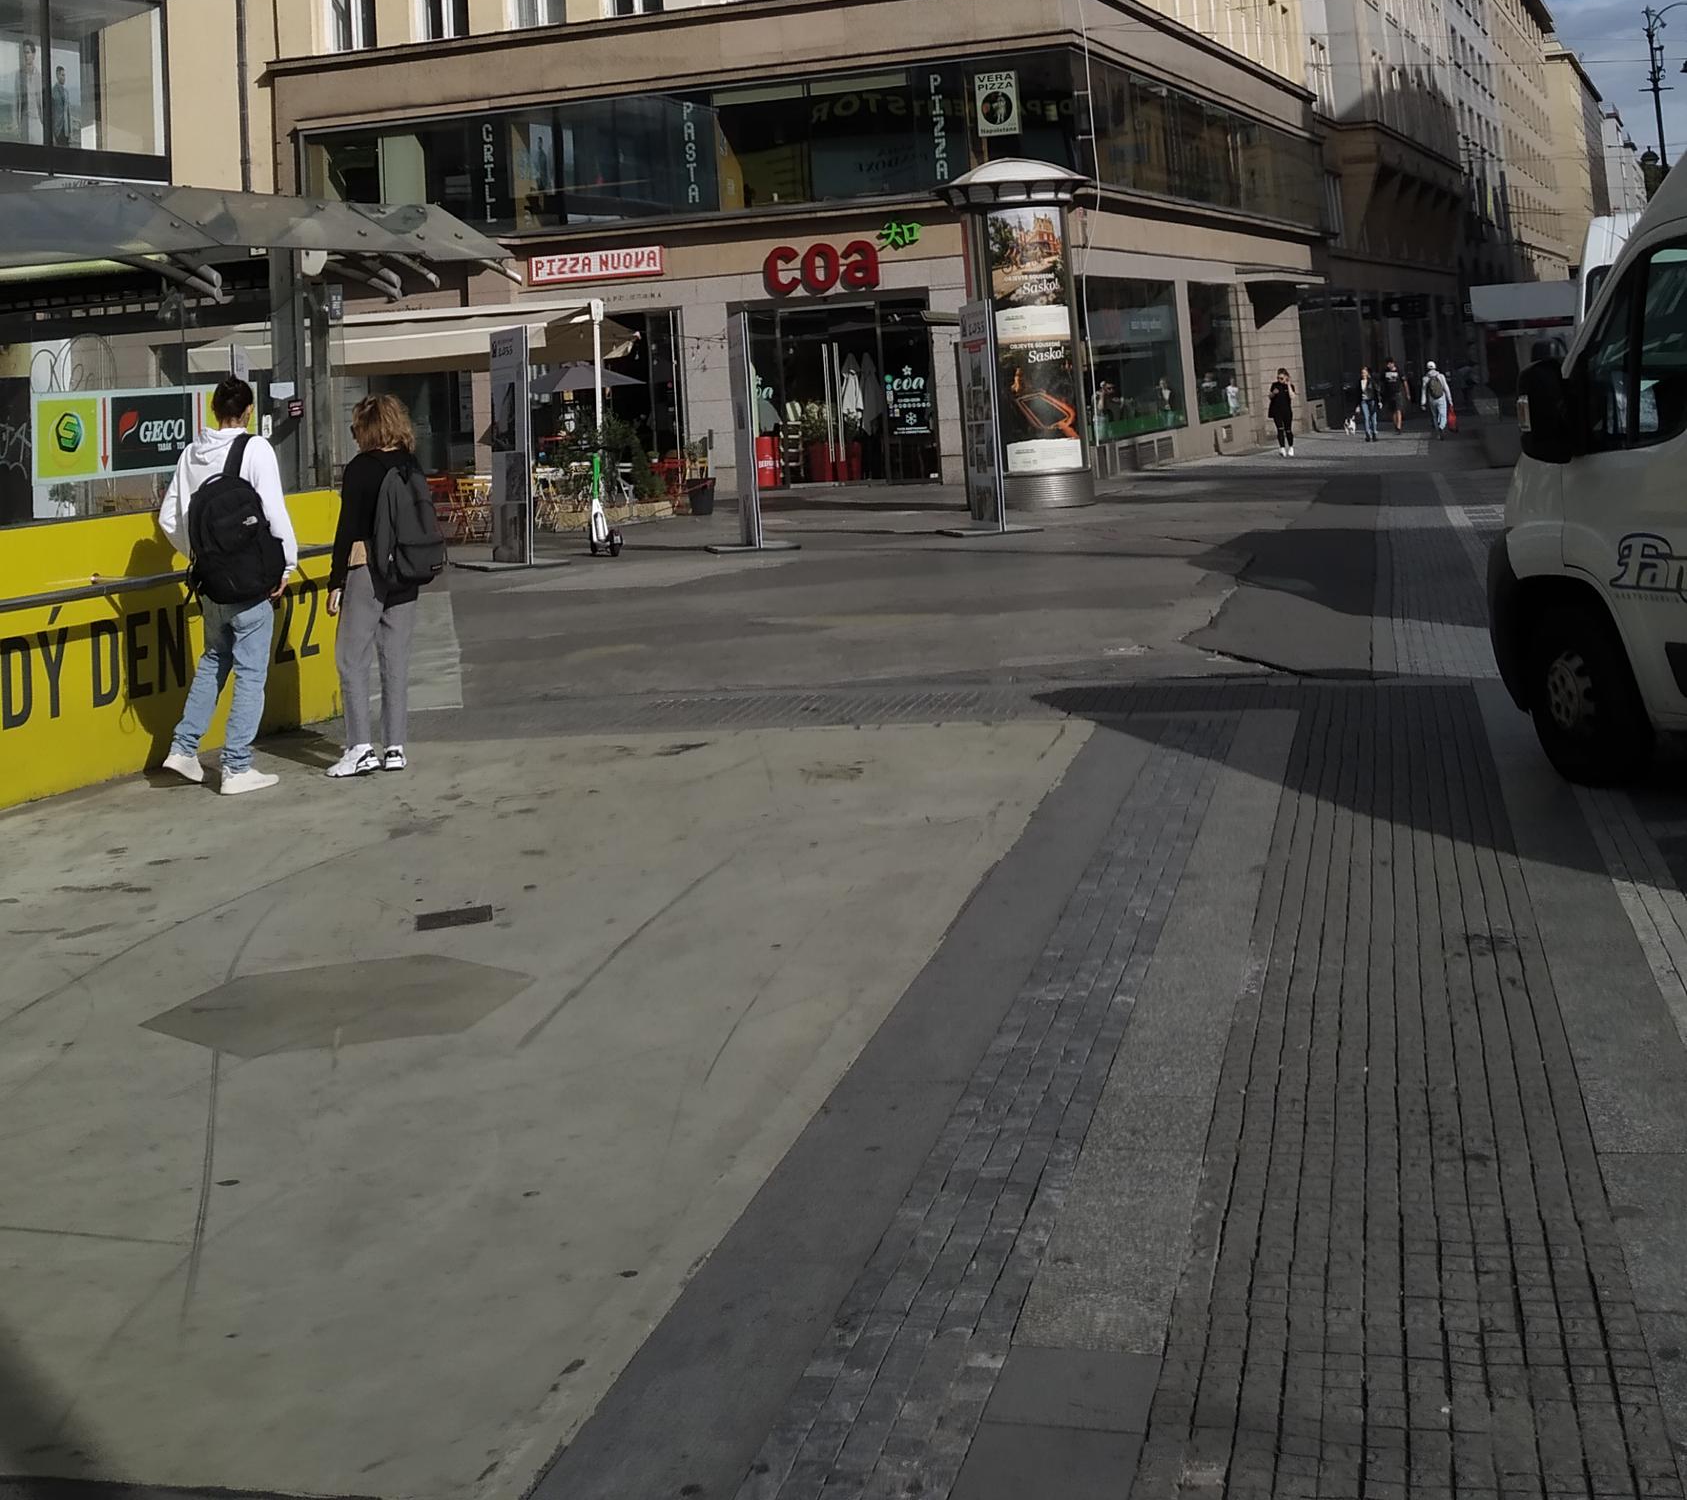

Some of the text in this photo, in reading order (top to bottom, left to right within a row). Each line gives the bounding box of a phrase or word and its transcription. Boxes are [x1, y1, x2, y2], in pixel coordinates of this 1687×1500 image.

[977, 73, 1013, 83] VERA
[977, 81, 1014, 91] PIZZA
[929, 73, 949, 180] PIZZA
[682, 101, 700, 204] PASTA
[482, 123, 498, 223] GRILL
[535, 250, 657, 278] PIZZA NUOVA
[763, 239, 880, 298] coa
[1022, 278, 1060, 295] Sasko!
[1028, 346, 1065, 363] Sasko!
[892, 376, 925, 391] coa
[139, 418, 186, 443] GECO
[90, 607, 187, 708] DEN
